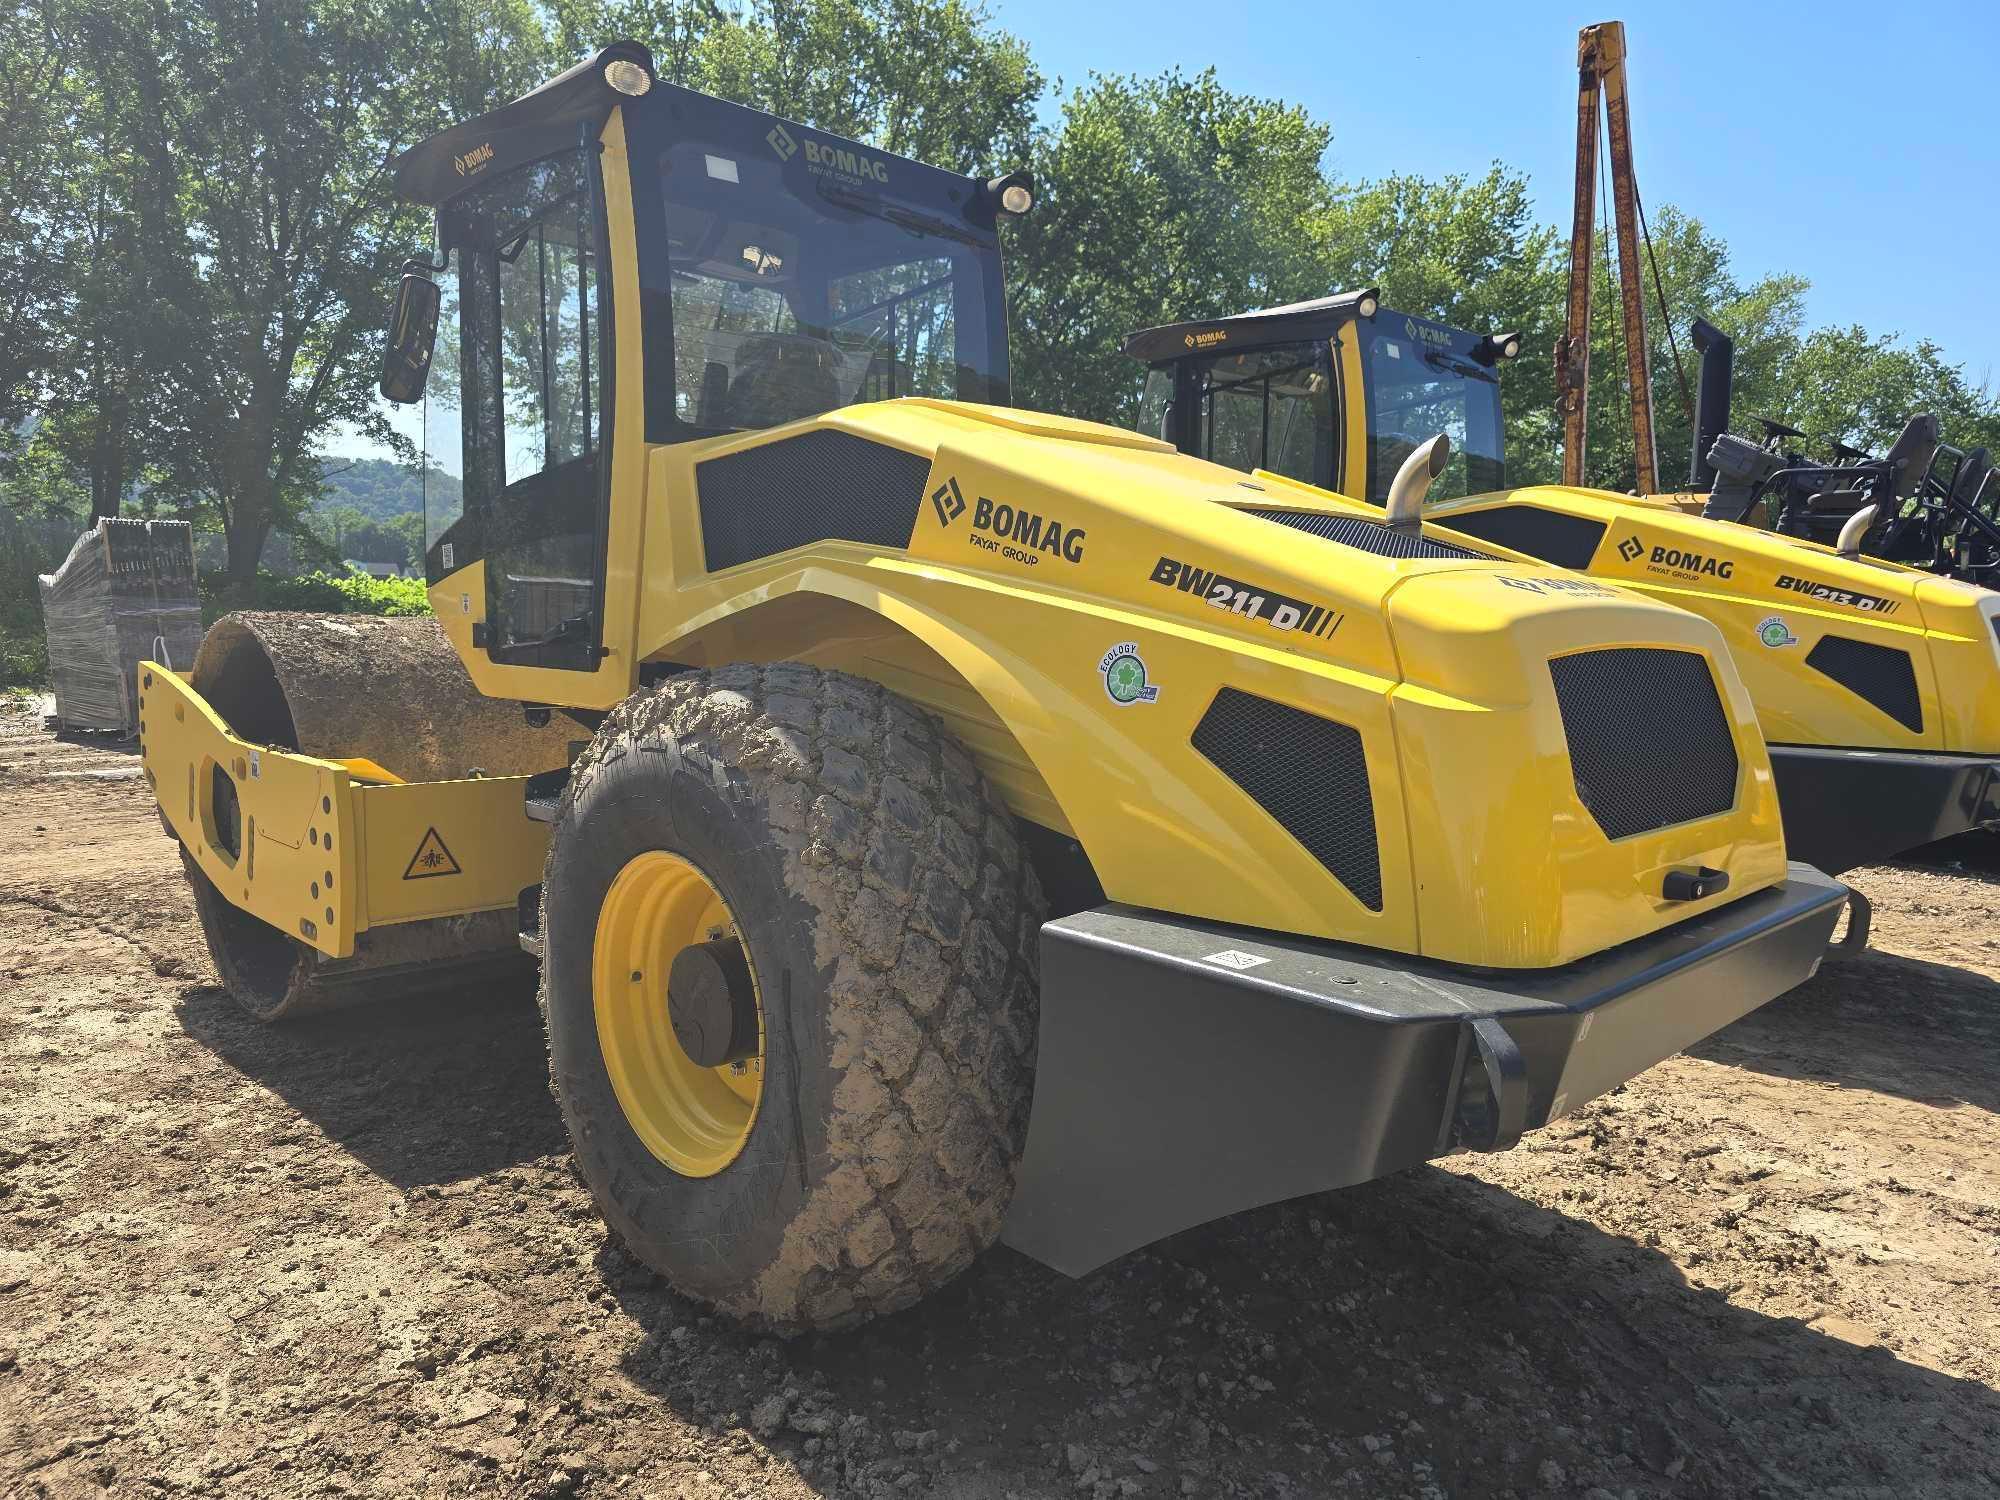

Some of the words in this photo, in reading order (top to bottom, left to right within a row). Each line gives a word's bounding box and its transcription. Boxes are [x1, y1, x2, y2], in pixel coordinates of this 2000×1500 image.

[464, 142, 494, 168] BOMAG
[804, 139, 889, 183] BOMAG
[1196, 331, 1226, 344] BOMAG
[1418, 326, 1452, 346] BOMAG
[973, 496, 1086, 564] BOMAG
[969, 533, 1000, 553] FAYAT
[1002, 546, 1038, 566] GROUP
[1650, 546, 1734, 579] BOMAG
[1647, 565, 1670, 576] FAYAT
[1672, 570, 1700, 581] GROUP
[1100, 644, 1136, 672] ECOLOGY
